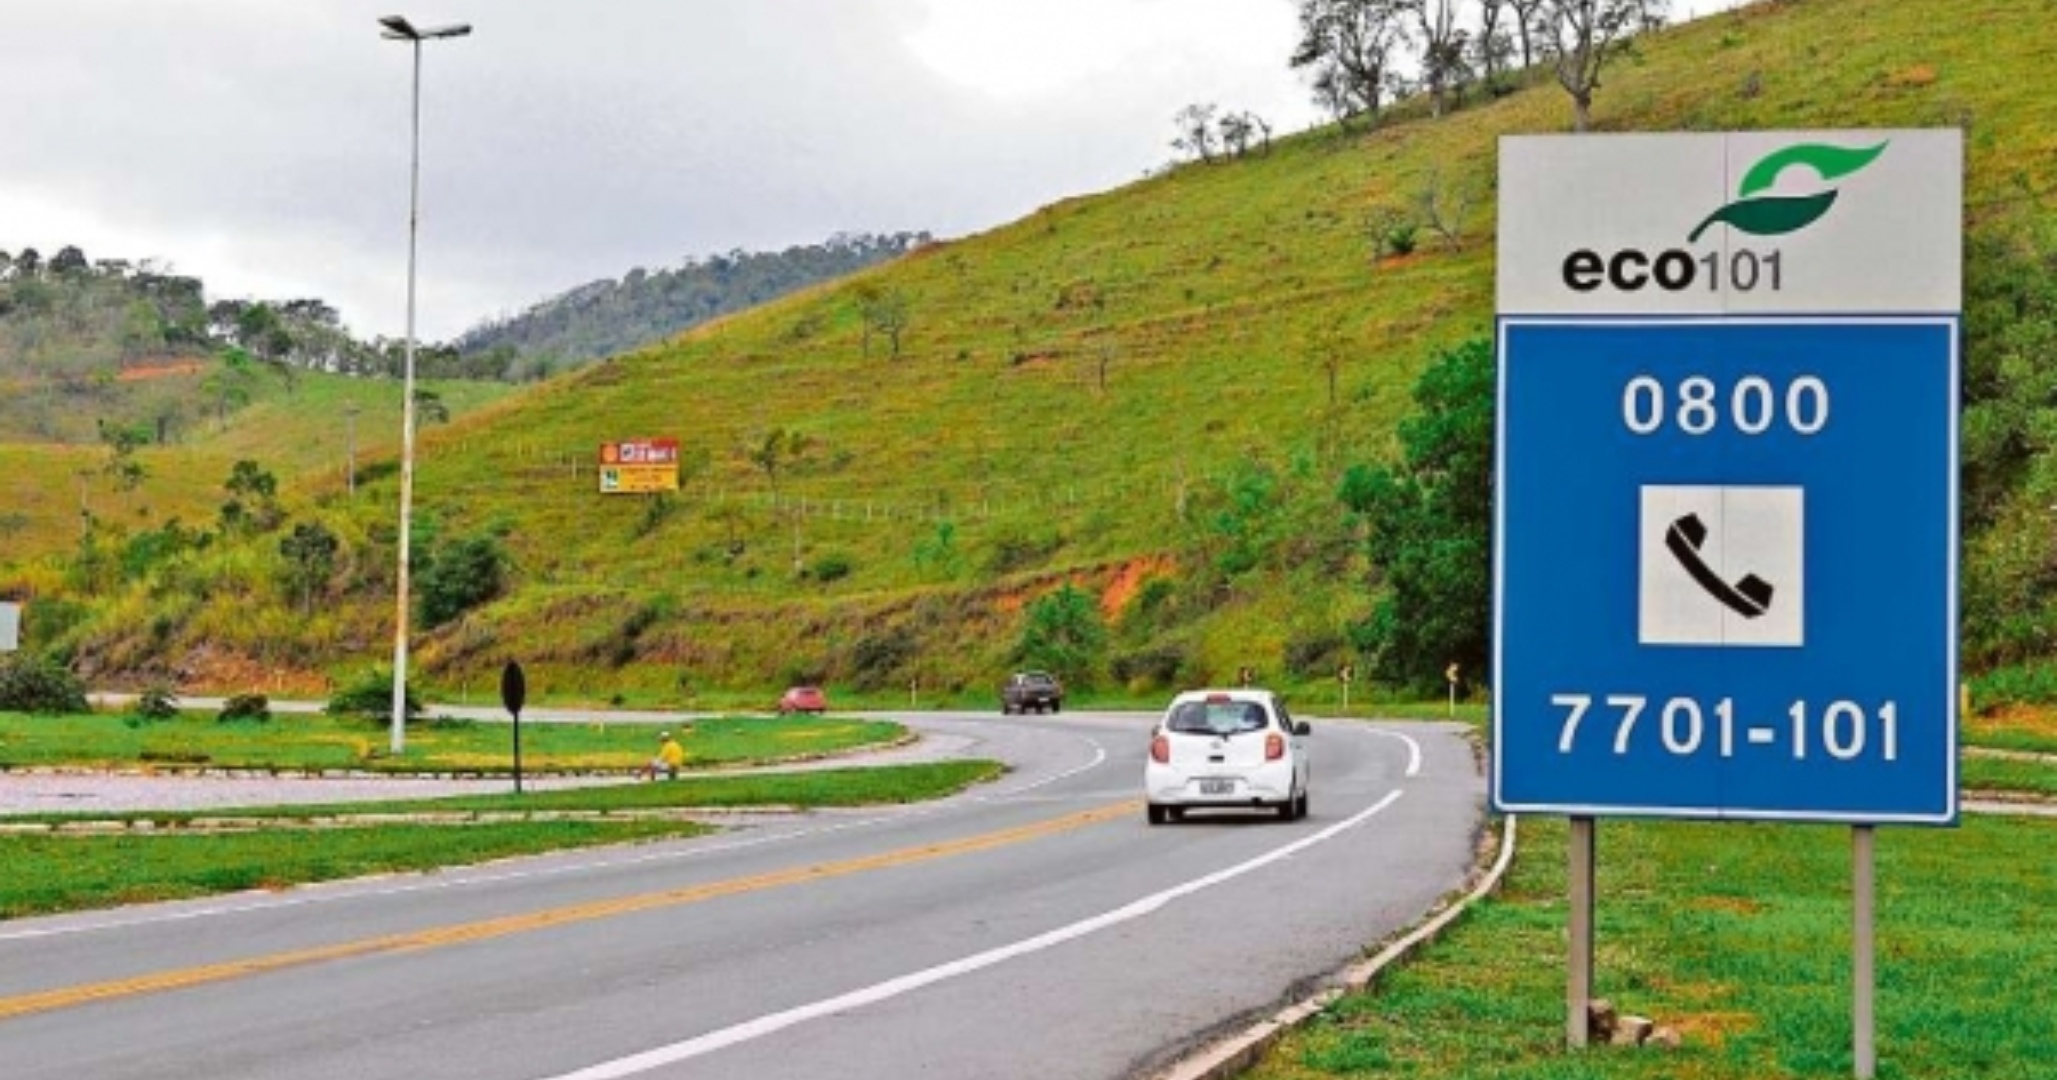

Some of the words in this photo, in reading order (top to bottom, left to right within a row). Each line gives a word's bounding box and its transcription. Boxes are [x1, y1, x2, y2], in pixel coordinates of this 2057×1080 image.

[1562, 248, 1781, 292] eco101
[1623, 376, 1828, 434] 0800
[1552, 695, 1898, 761] 7701-101
